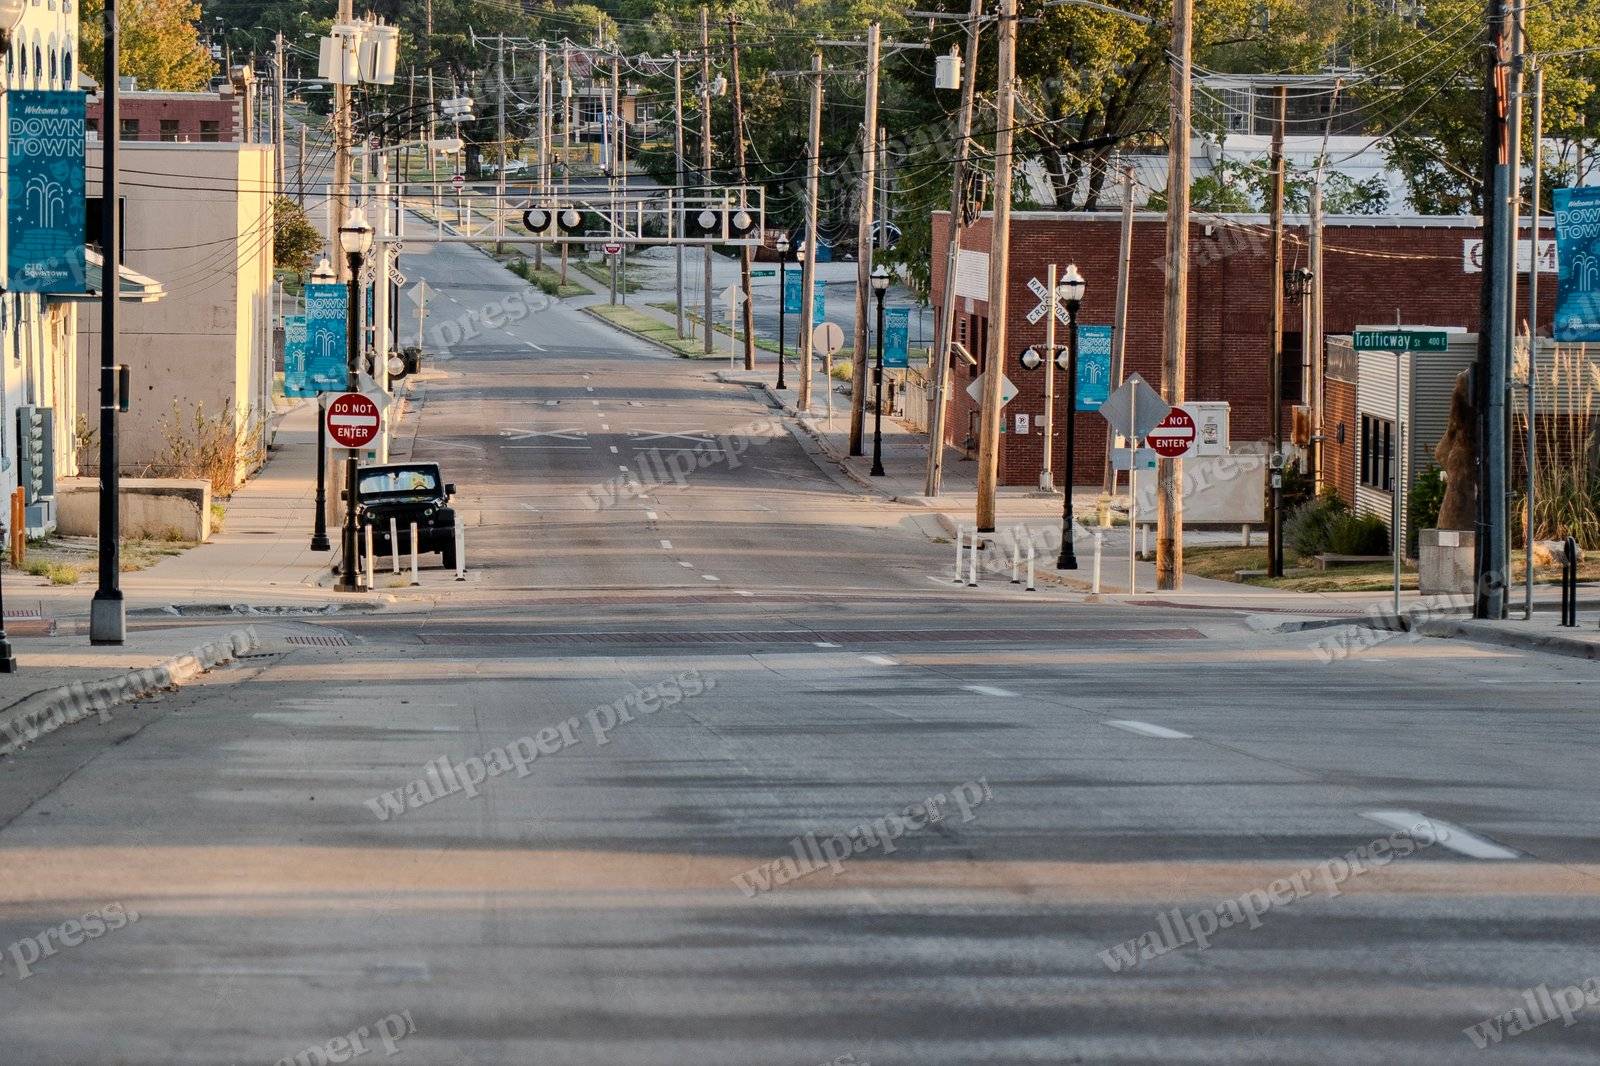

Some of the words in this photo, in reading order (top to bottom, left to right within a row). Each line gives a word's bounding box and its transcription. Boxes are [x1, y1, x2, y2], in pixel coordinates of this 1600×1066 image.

[24, 105, 58, 114] Welcome
[60, 107, 69, 115] to
[9, 117, 85, 136] DOWN
[9, 138, 85, 157] TOWN
[1556, 208, 1600, 225] DOW
[1557, 224, 1600, 240] TOW
[306, 298, 347, 308] DOWN
[306, 309, 347, 319] TOWN
[1355, 332, 1411, 350] Trafficway
[1428, 337, 1440, 346] 400
[1441, 338, 1447, 346] E
[335, 404, 348, 413] DO
[352, 404, 372, 414] NOT
[1169, 416, 1188, 425] NOT
[337, 428, 368, 439] ENTER
[1156, 439, 1185, 448] ENTER
